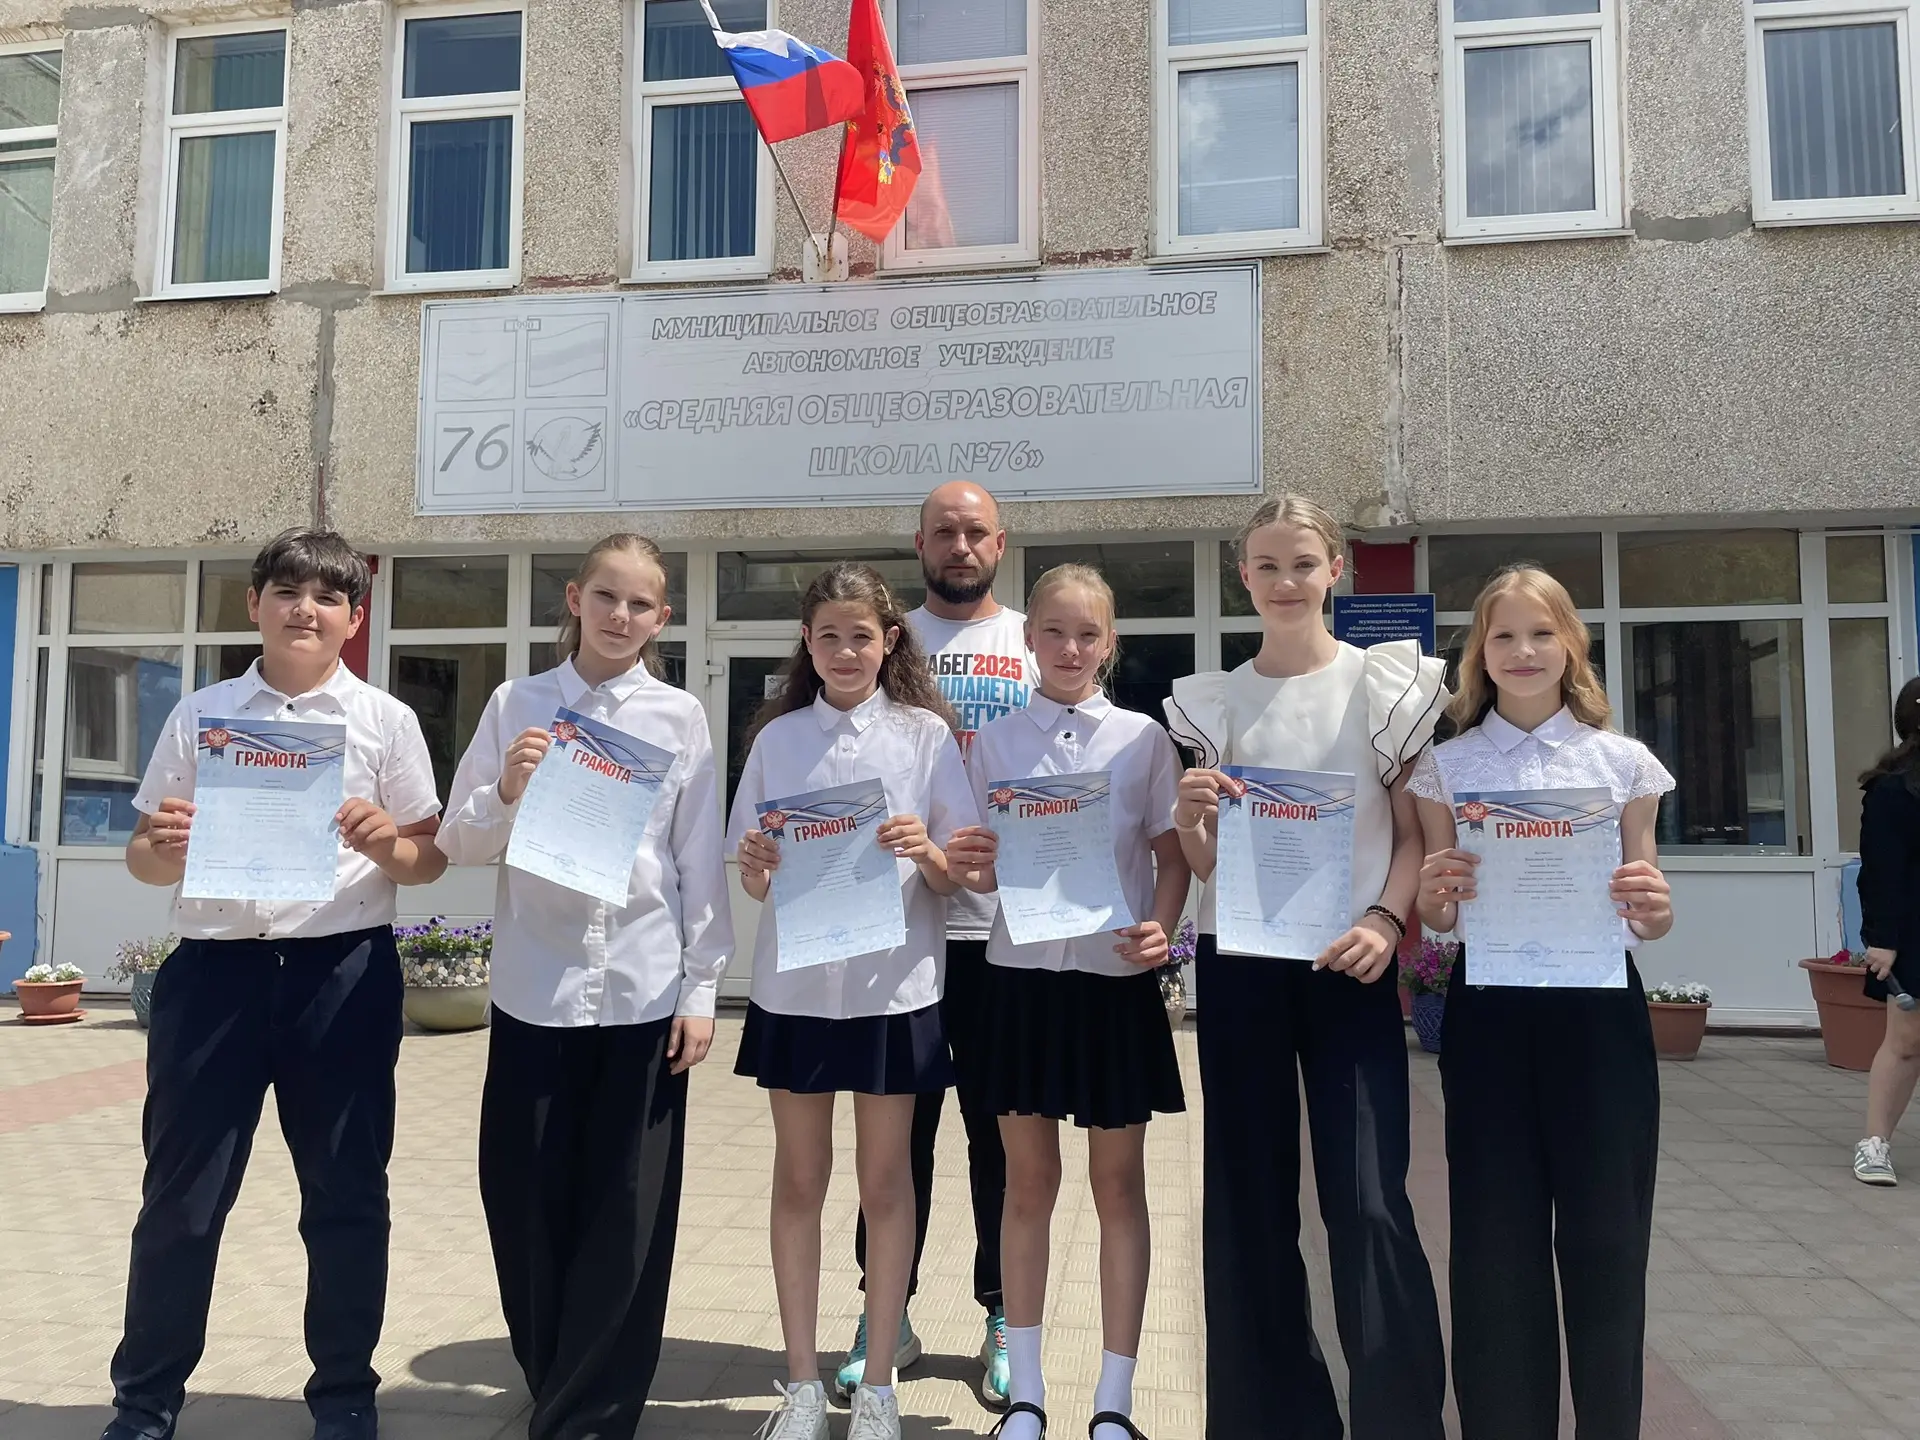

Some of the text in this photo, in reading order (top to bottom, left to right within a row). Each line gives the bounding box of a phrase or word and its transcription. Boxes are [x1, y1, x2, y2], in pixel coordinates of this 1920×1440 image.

[652, 291, 1218, 340] МУНИЦИПАЛЬНОЕ ОБЩЕОБРАЗОВАТЕЛЬНОЕ
[742, 336, 1115, 374] АВТОНОМНОЕ УЧРЕЖДЕНИЕ
[623, 376, 1249, 434] «СРЕДНЯЯ ОБЩЕОБРАЗОВАТЕЛЬНАЯ
[439, 424, 511, 473] 76
[808, 440, 1045, 477] ШКОЛА №76»
[928, 653, 1022, 680] АБЕГ2025
[235, 751, 307, 769] ГРАМОТА
[571, 748, 632, 784] ГРАМОТА
[1019, 798, 1079, 818] ГРАМОТА
[1251, 801, 1318, 821] ГРАМОТА
[794, 816, 857, 842] ГРАМОТА
[1495, 820, 1574, 839] ГРАМОТА
